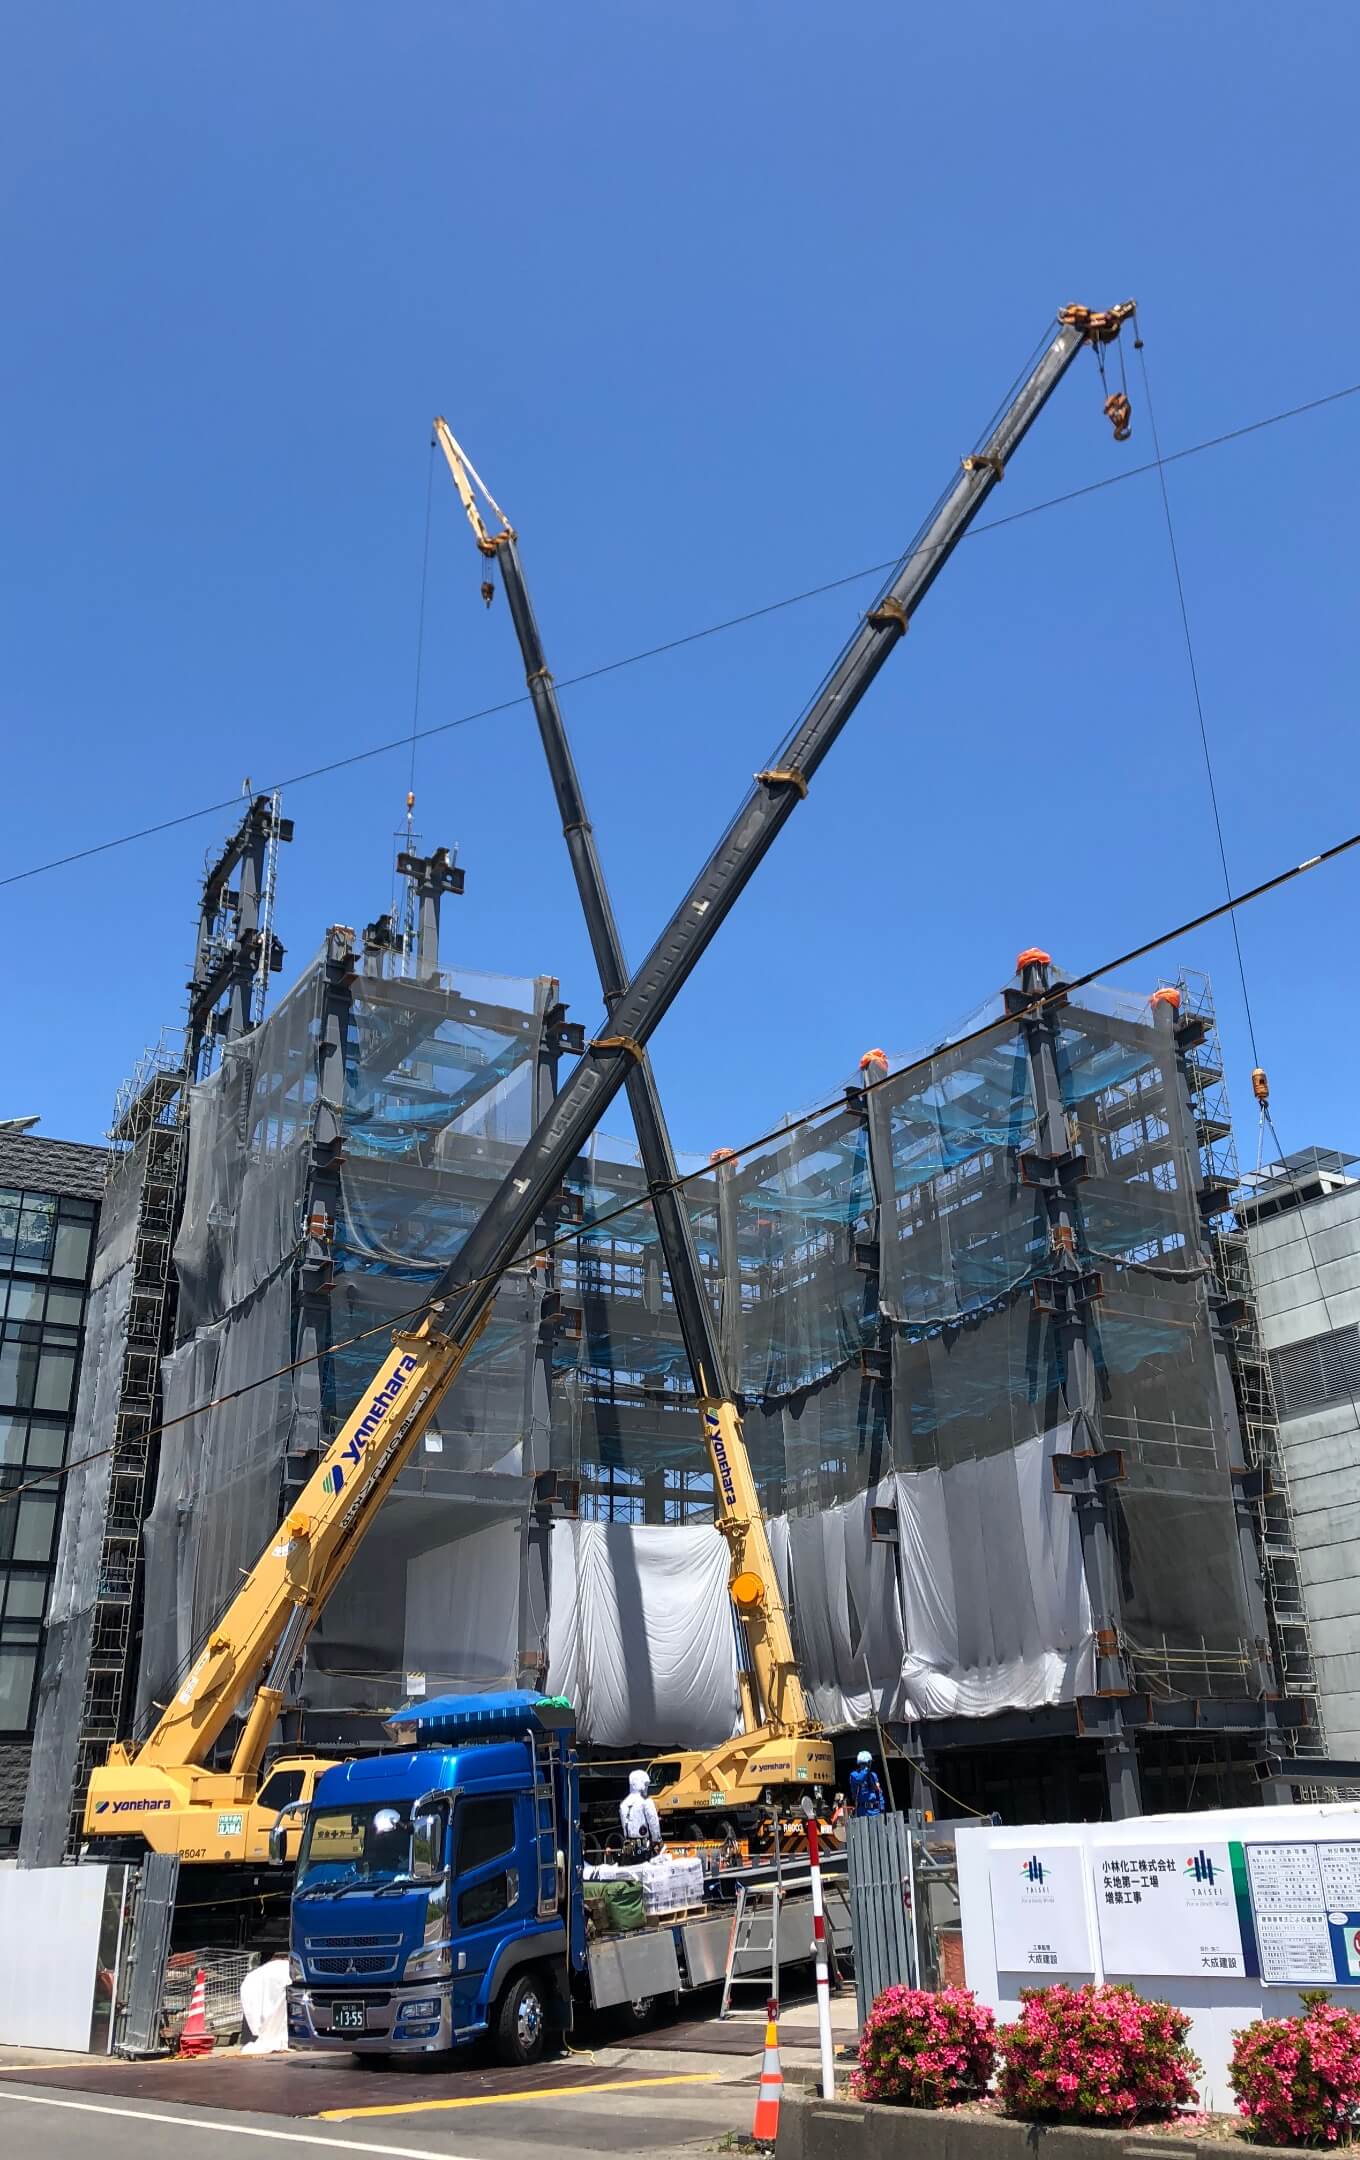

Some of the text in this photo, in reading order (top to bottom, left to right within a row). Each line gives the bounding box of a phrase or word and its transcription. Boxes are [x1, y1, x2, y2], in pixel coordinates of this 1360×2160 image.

[1102, 1858, 1177, 1874] 小林化工株式会社
[1103, 1875, 1159, 1889] 矢地第一工場
[1105, 1891, 1142, 1905] 増築工事
[1201, 1956, 1237, 1969] 大成建設
